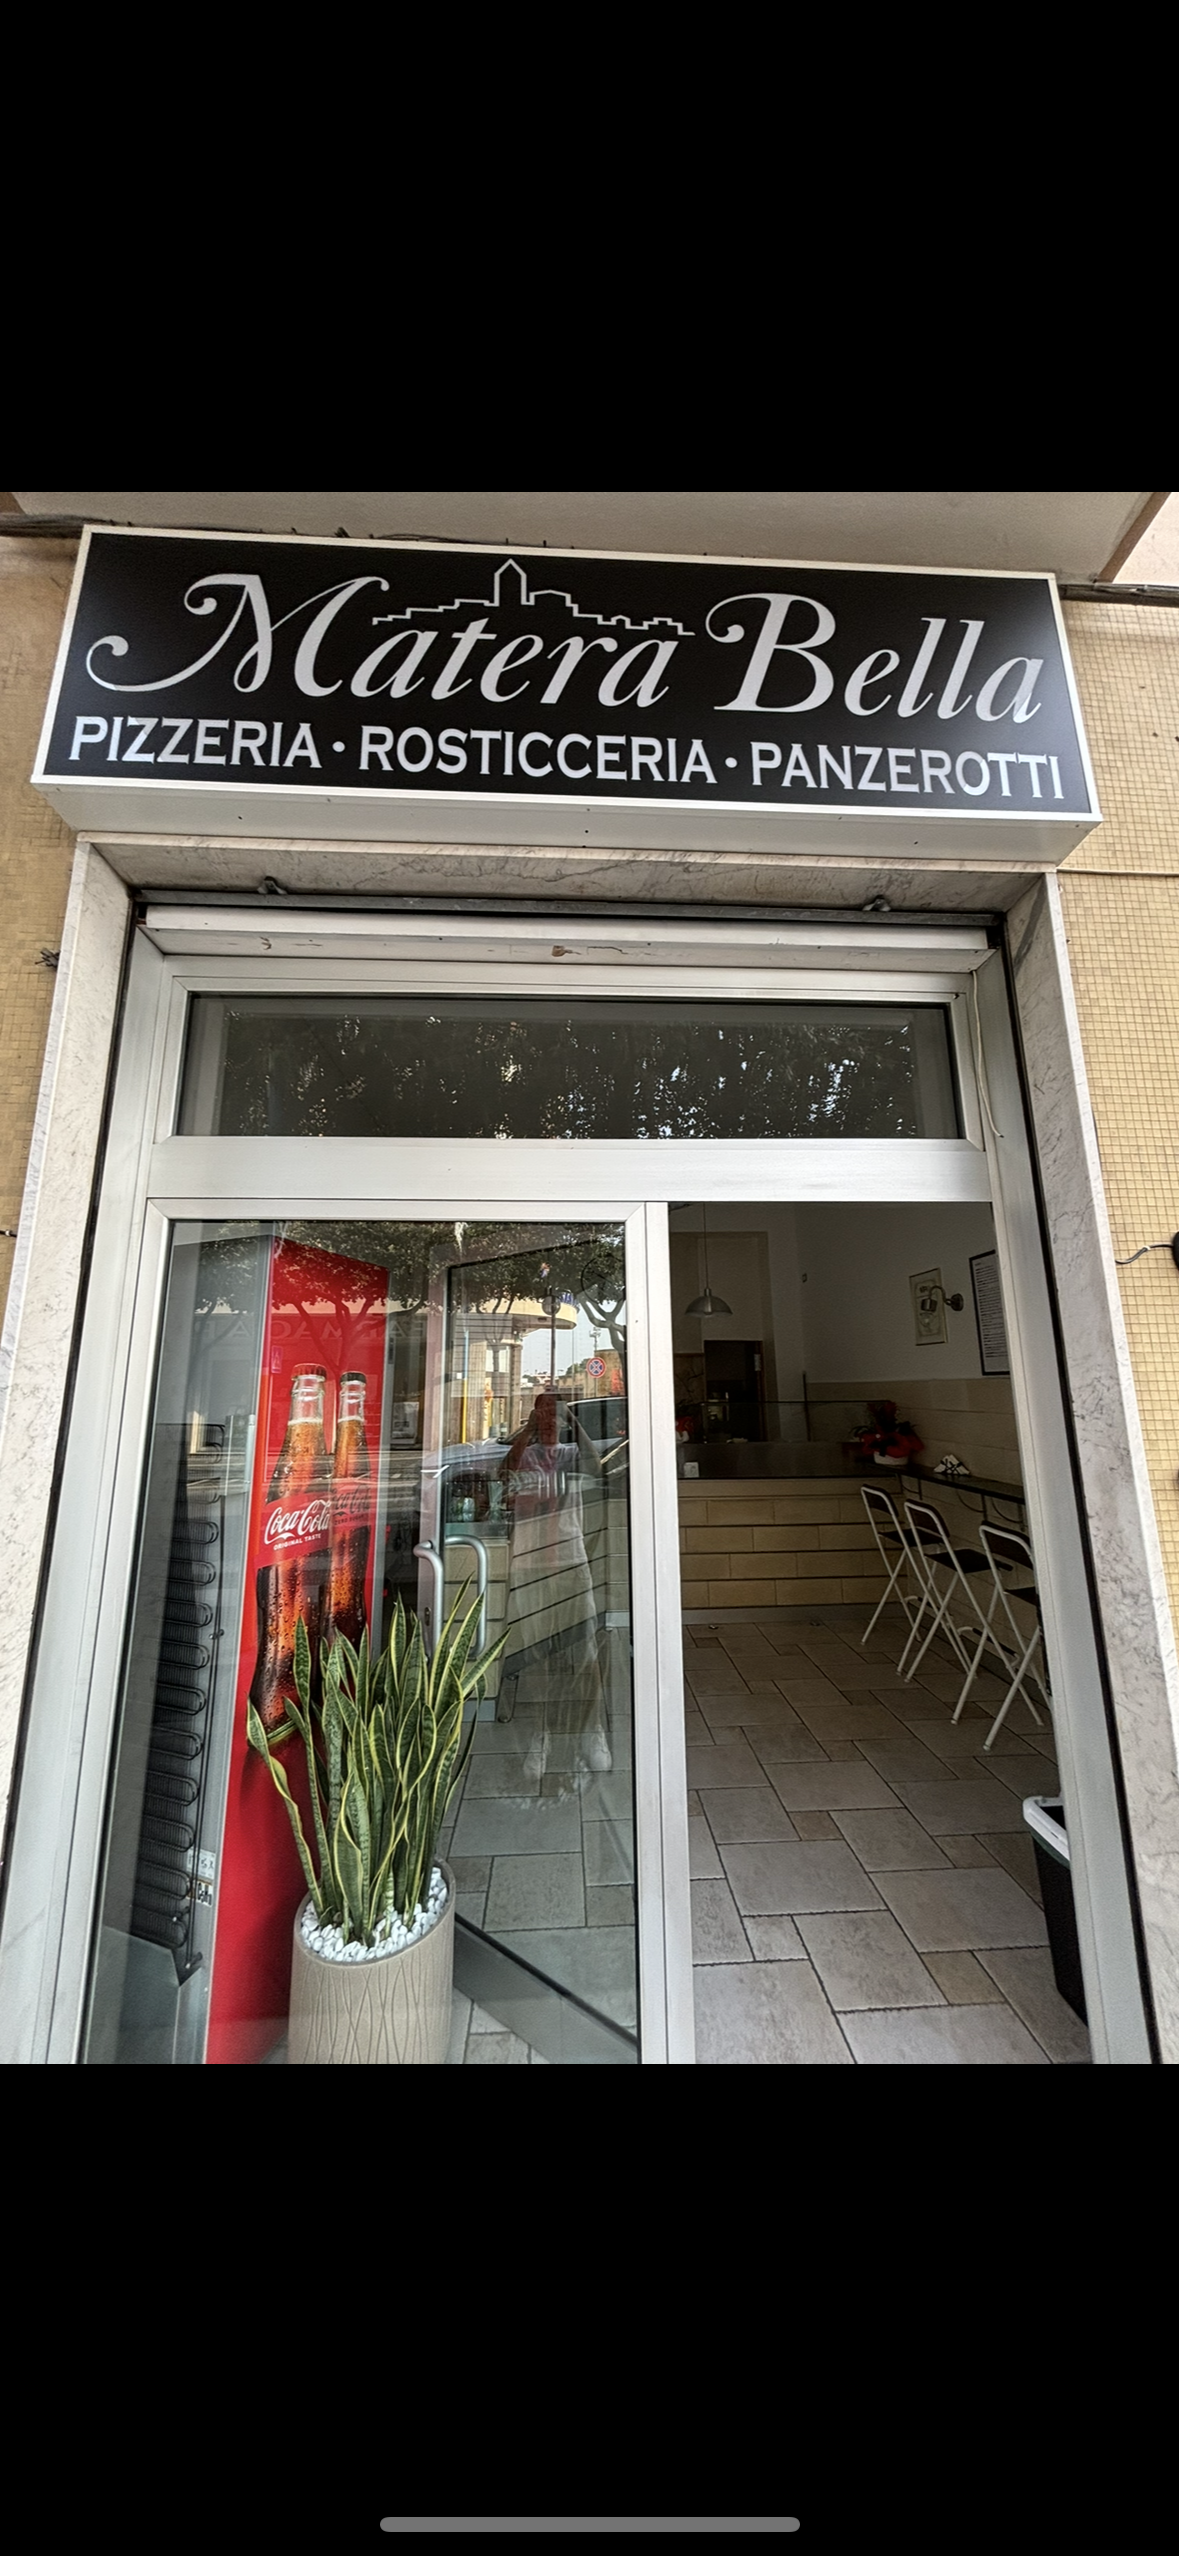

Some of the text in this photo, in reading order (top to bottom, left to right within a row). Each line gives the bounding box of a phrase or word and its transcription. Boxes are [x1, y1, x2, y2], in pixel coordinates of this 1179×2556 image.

[86, 572, 1044, 724] Matera Bella
[69, 715, 1065, 800] PIZZERIA ROSTICCERIA PANZEROTTI
[264, 1499, 332, 1545] Coca-Cola
[273, 1533, 322, 1551] ORIGINAL TASTE
